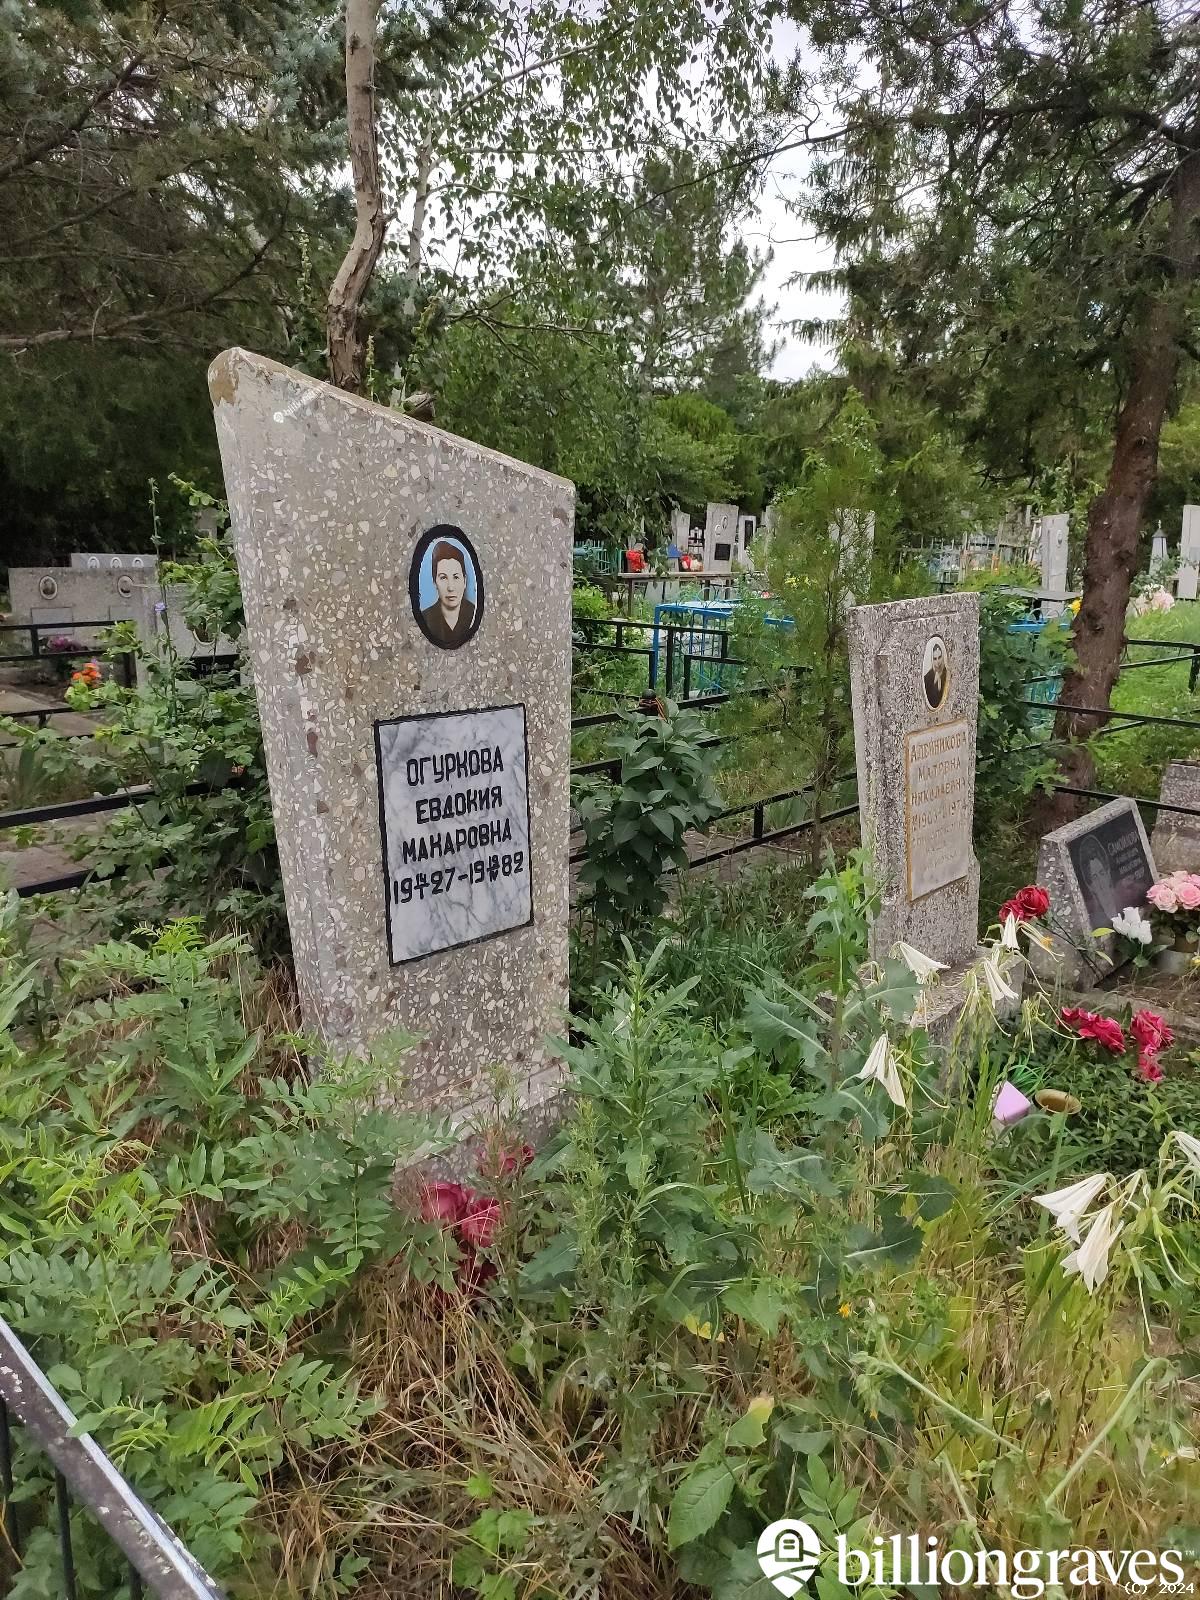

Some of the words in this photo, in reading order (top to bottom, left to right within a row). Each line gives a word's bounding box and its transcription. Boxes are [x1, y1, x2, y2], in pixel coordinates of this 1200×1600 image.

[406, 746, 504, 787] ОГУРКОВА
[416, 786, 503, 825] ЕВДОКИЯ
[402, 818, 512, 865] МАКАРОВНА
